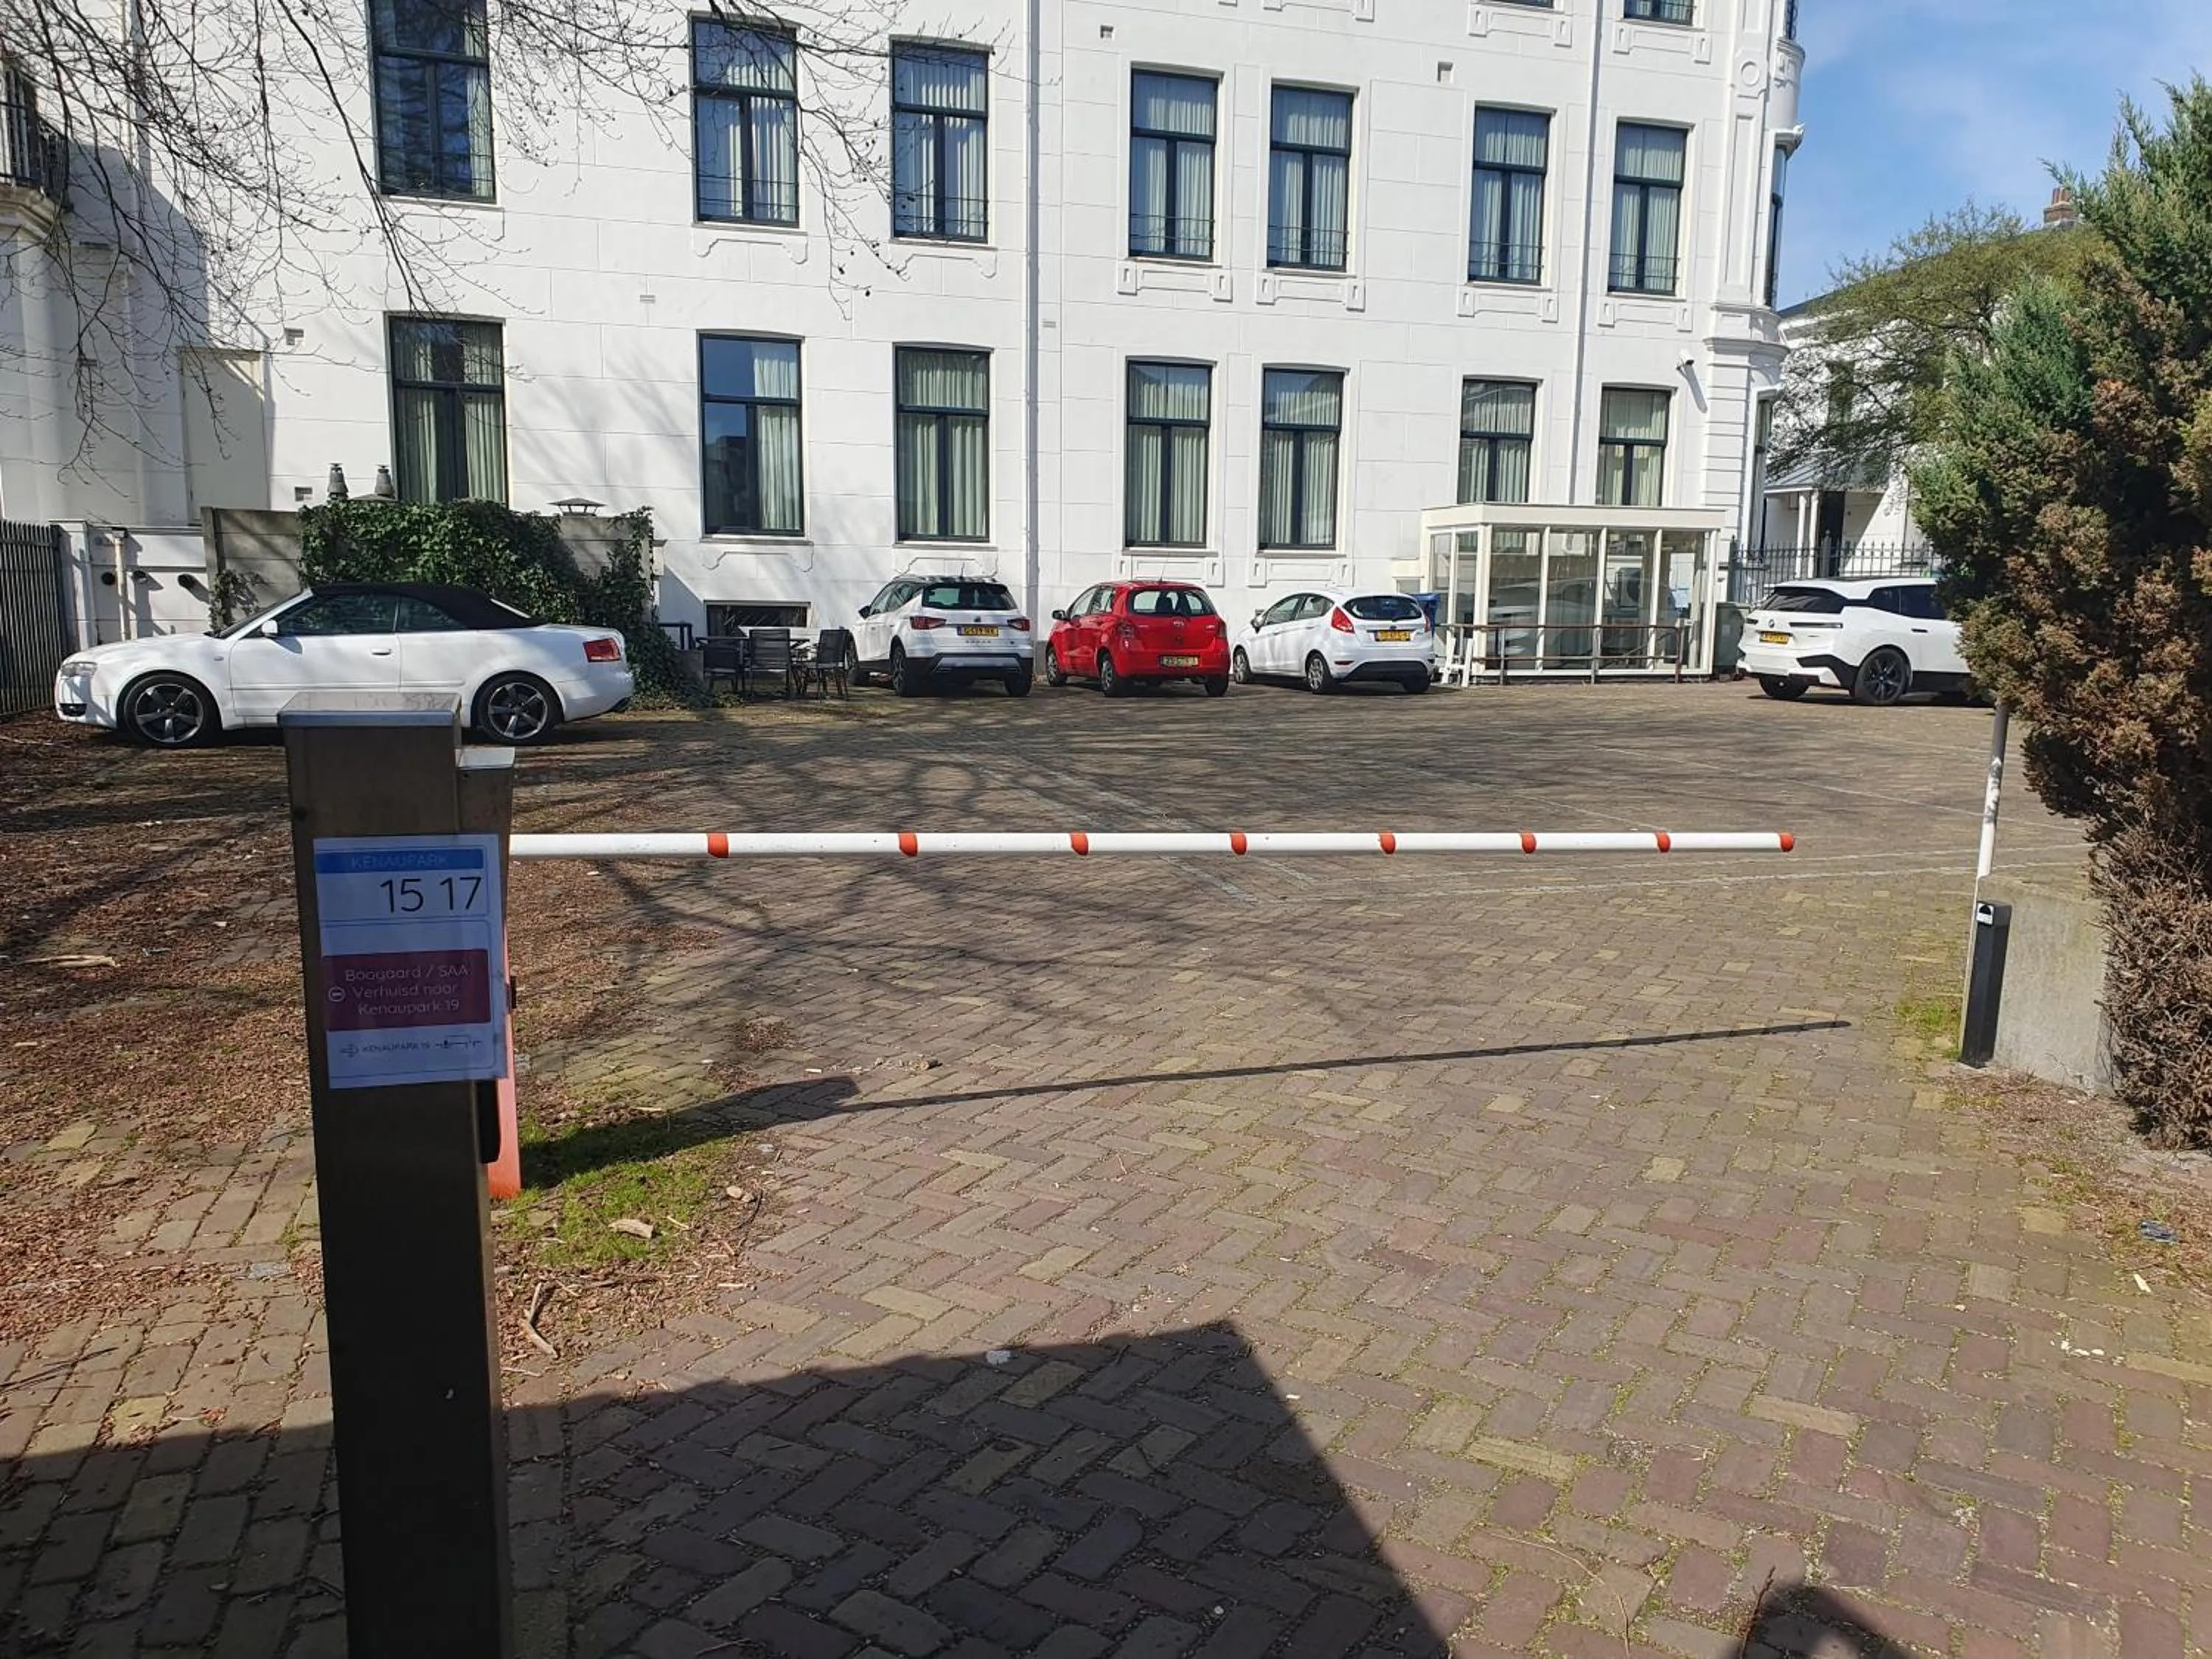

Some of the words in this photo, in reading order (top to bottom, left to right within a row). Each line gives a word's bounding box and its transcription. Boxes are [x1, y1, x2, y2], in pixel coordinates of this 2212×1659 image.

[352, 853, 448, 869] KENAUPARK
[380, 879, 424, 913] 15
[439, 877, 482, 910] 17
[352, 984, 419, 998] Verhuisd
[423, 984, 458, 996] naar
[358, 1000, 442, 1016] Kenaupark
[445, 999, 460, 1012] 19
